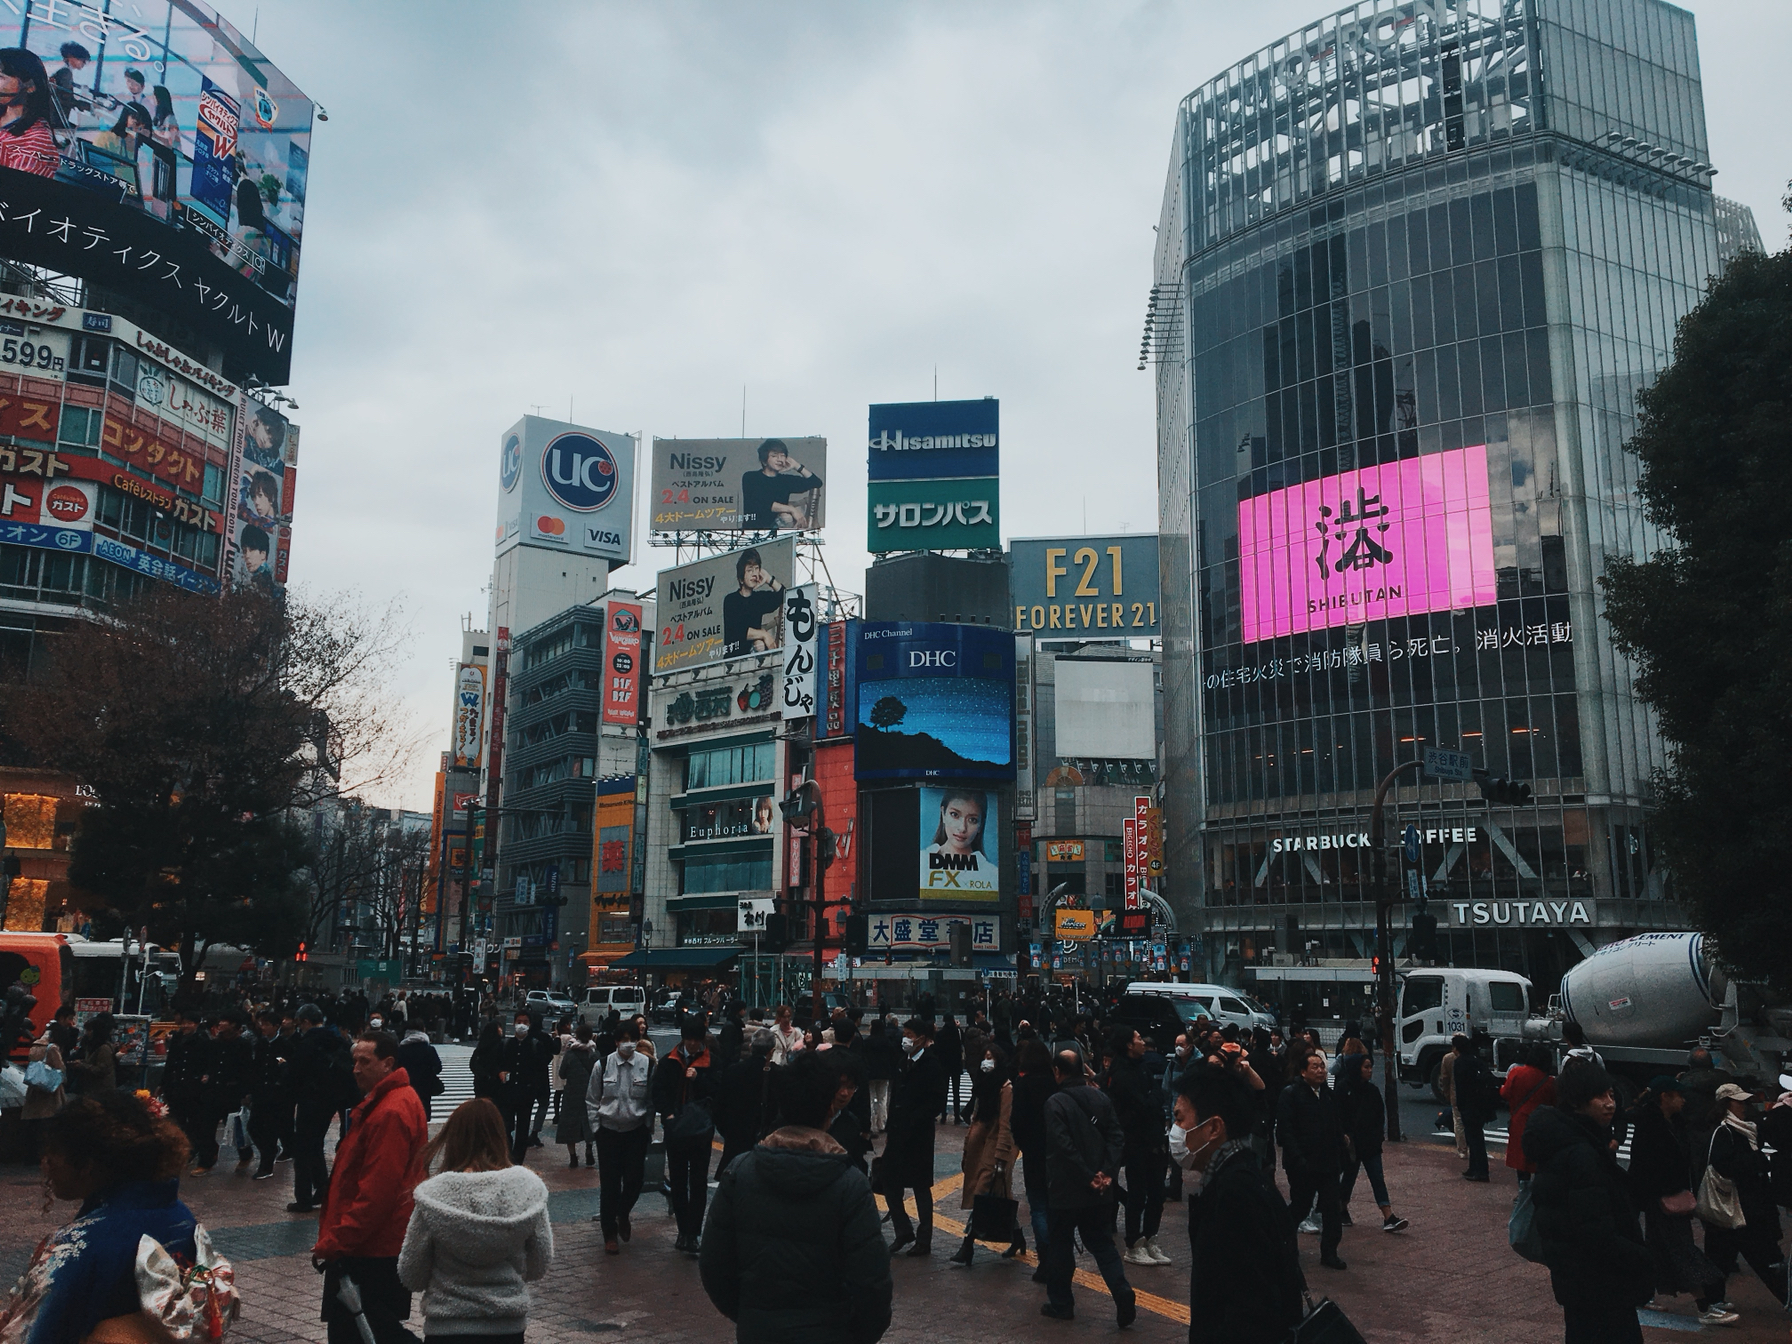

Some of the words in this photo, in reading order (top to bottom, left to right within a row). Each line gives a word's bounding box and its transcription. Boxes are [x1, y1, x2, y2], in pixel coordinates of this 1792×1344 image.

[207, 110, 232, 134] ヤクルト
[213, 134, 237, 160] W
[194, 277, 258, 335] ヤクルト
[267, 323, 285, 352] W
[169, 383, 227, 435] しゃぶ葉
[237, 427, 245, 450] TRAIN
[869, 429, 996, 451] Hisamitsu
[103, 418, 200, 483] コンタクト
[670, 452, 727, 473] Nissy
[671, 480, 725, 488] ベストアルバム
[52, 500, 84, 512] ガスト
[230, 488, 238, 511] TOUR
[661, 488, 690, 505] 2.4
[692, 496, 709, 504] ON
[711, 496, 734, 504] SALE
[173, 497, 216, 531] ガスト
[655, 507, 737, 524] 4大ドームツアー
[873, 500, 992, 528] サロンパス
[58, 532, 80, 547] 6F
[588, 528, 621, 545] VISA
[1315, 486, 1393, 580] 渋
[100, 540, 132, 563] AEON
[1046, 546, 1122, 598] F21
[669, 575, 716, 602] Nissy
[1307, 585, 1403, 614] SHIBUTAN
[670, 607, 713, 622] ベストアルバム
[1016, 603, 1124, 630] FOREVER
[1131, 602, 1156, 627] 21
[662, 623, 685, 646] 2.4
[686, 630, 700, 641] ON
[702, 624, 721, 636] SALE
[864, 630, 881, 640] DHC
[882, 628, 913, 638] Channel
[1477, 621, 1573, 651] 消火活動
[656, 637, 724, 669] 4大ドームツアー
[784, 587, 815, 714] もんじゃ
[909, 650, 956, 668] DHC
[612, 690, 632, 703] B2F
[1428, 751, 1469, 769] 渋谷駅前
[1434, 765, 1454, 776] Shibuya
[690, 823, 749, 839] Euphoria
[1273, 832, 1372, 852] STARBUCK
[1401, 827, 1477, 844] FFEE
[929, 853, 979, 871] DMM
[928, 870, 961, 888] FX
[969, 881, 992, 889] ROLA
[1453, 901, 1590, 924] TSUTAYA
[1447, 1021, 1465, 1032] 1031
